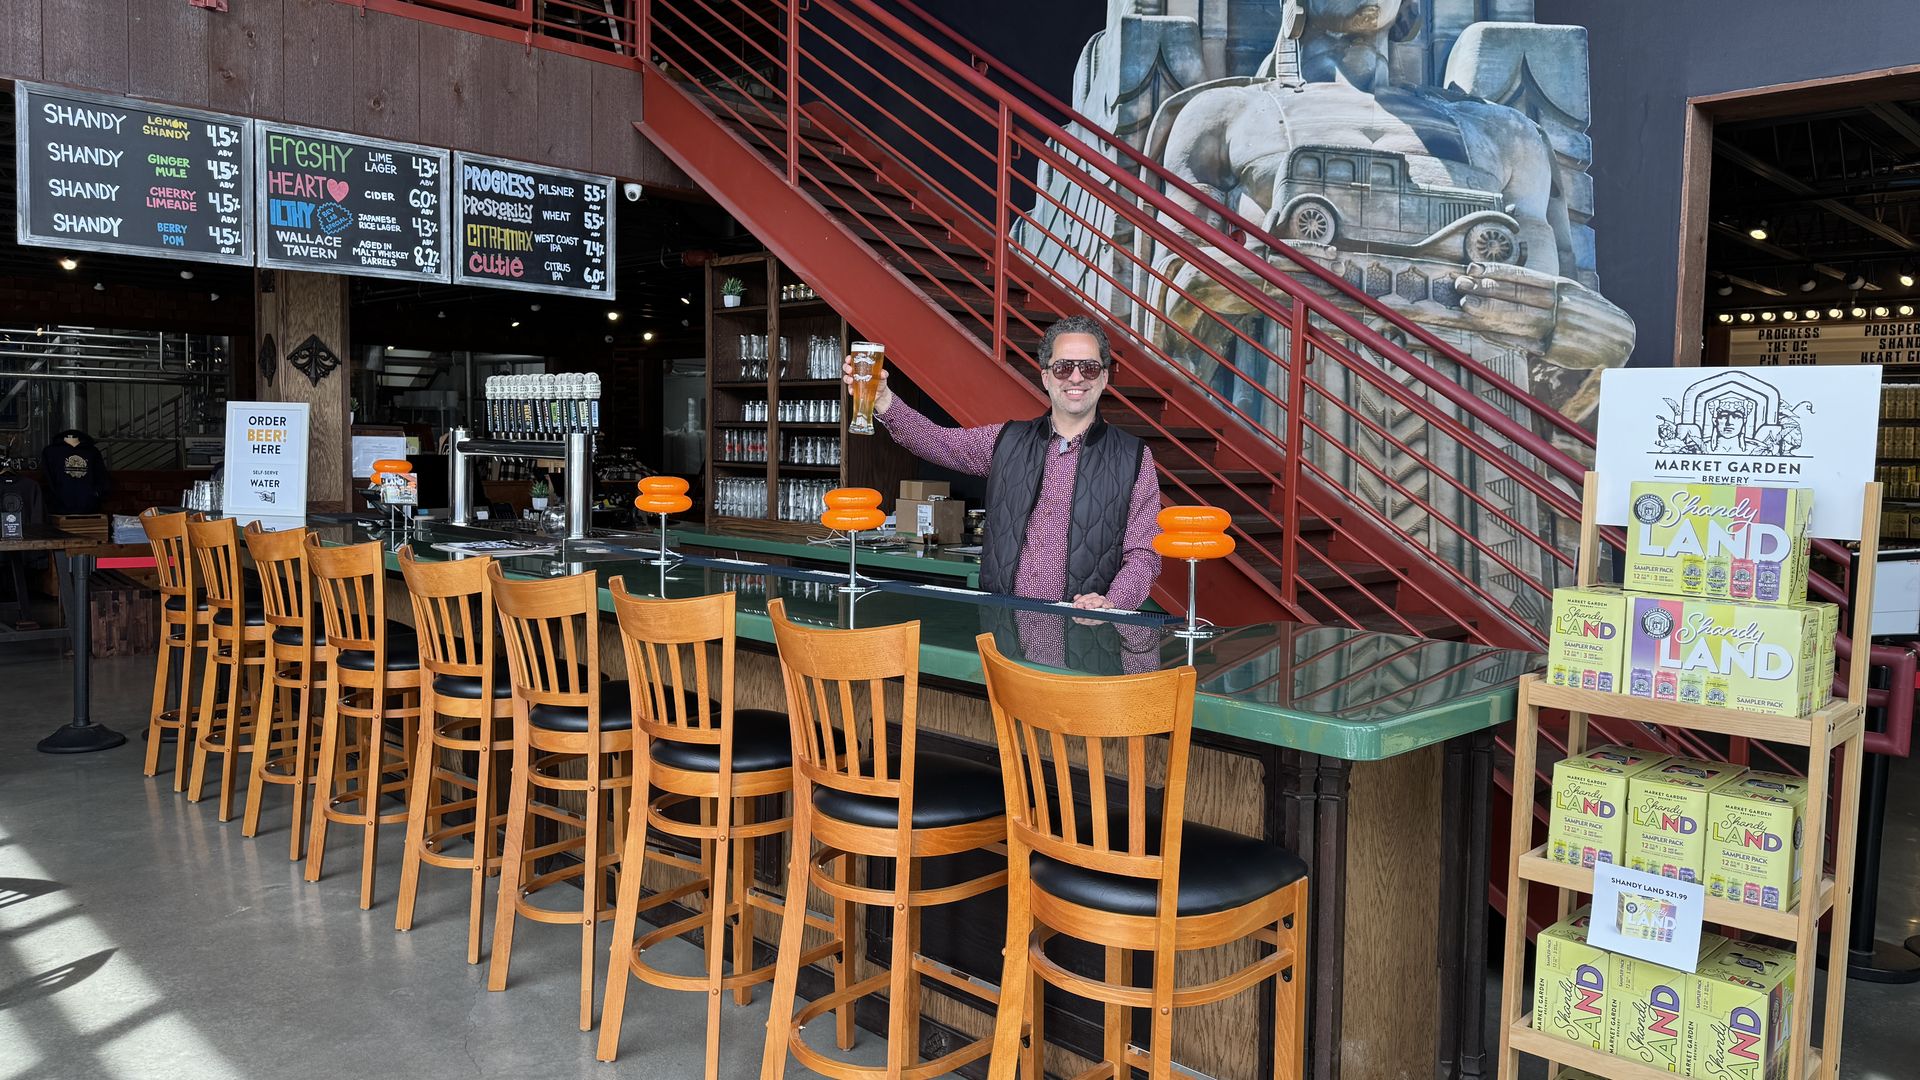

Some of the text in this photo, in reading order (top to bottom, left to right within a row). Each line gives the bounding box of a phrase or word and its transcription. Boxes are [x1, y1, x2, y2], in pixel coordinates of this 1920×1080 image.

[44, 103, 126, 134] SHANDY
[142, 126, 190, 141] SHANDY
[206, 124, 239, 147] 4.5%
[48, 142, 124, 168] SHANDY
[148, 154, 190, 168] GINGER
[368, 152, 392, 163] LIME
[156, 166, 188, 178] MULE
[207, 160, 239, 180] 4.5%
[364, 162, 397, 174] LAGER
[412, 156, 439, 178] 4.3%
[48, 178, 120, 201] SHANDY
[269, 170, 327, 199] HEART
[464, 164, 535, 200] PROGRESS
[150, 187, 196, 200] CHERRY
[364, 190, 395, 201] CIDER
[409, 189, 438, 208] 6.0%
[539, 183, 574, 198] PILSNER
[584, 184, 606, 202] 5.5%
[146, 196, 198, 212] LIMEADE
[208, 192, 240, 213] 4.5%
[220, 215, 238, 224] ABV
[542, 211, 571, 222] WHEAT
[584, 212, 605, 230] 5.5%
[53, 213, 122, 237] SHANDY
[157, 222, 188, 234] BERRY
[359, 221, 402, 232] RICE LAGER
[412, 217, 438, 237] 4.3%
[163, 235, 184, 246] POM
[208, 226, 241, 245] 4.5%
[276, 230, 342, 247] WALLACE
[467, 223, 534, 252] CITRAMAX
[534, 233, 579, 246] WEST COAST
[283, 244, 337, 259] TAVERN
[359, 240, 382, 250] AGED
[550, 243, 562, 253] IPA
[583, 240, 605, 257] 7.4%
[352, 248, 409, 260] MALT WHISKEY
[361, 257, 397, 267] BARRELS
[414, 246, 440, 266] 8.2%
[544, 261, 571, 272] CITRUS
[552, 272, 563, 281] IPA
[583, 267, 605, 283] 6.0%
[1759, 328, 1819, 340] PROGRESS
[1768, 341, 1788, 352] THE
[1760, 354, 1779, 365] PIN
[1861, 352, 1901, 363] HEART
[248, 416, 287, 426] ORDER
[248, 429, 287, 443] BEER!
[252, 445, 281, 454] HERE
[1654, 459, 1801, 475] MARKET GARDEN
[250, 479, 280, 488] WATER
[1702, 475, 1750, 484] BREWERY
[1662, 491, 1759, 535] Shandy
[1640, 519, 1792, 564] LAND
[1563, 606, 1603, 627] Shandy
[1556, 616, 1616, 640] LAND
[1675, 612, 1763, 653] Shandy
[1660, 636, 1794, 681] LAND
[1737, 697, 1765, 706] SAMPLER
[1563, 783, 1603, 805] Shandy
[1556, 791, 1616, 818] LAND
[1640, 798, 1682, 820] Shandy
[1564, 817, 1588, 827] SAMPLER
[1633, 807, 1697, 834] LAND
[1721, 813, 1767, 838] Shandy
[1642, 833, 1668, 843] SAMPLER
[1713, 822, 1783, 852] LAND
[1722, 850, 1750, 861] SAMPLER
[1611, 877, 1688, 900] SHANDY LAND $21.99
[1627, 913, 1677, 930] LAND
[1554, 977, 1584, 1040] Shandy
[1627, 999, 1658, 1062] Shandy
[1705, 1021, 1739, 1080] Shandy
